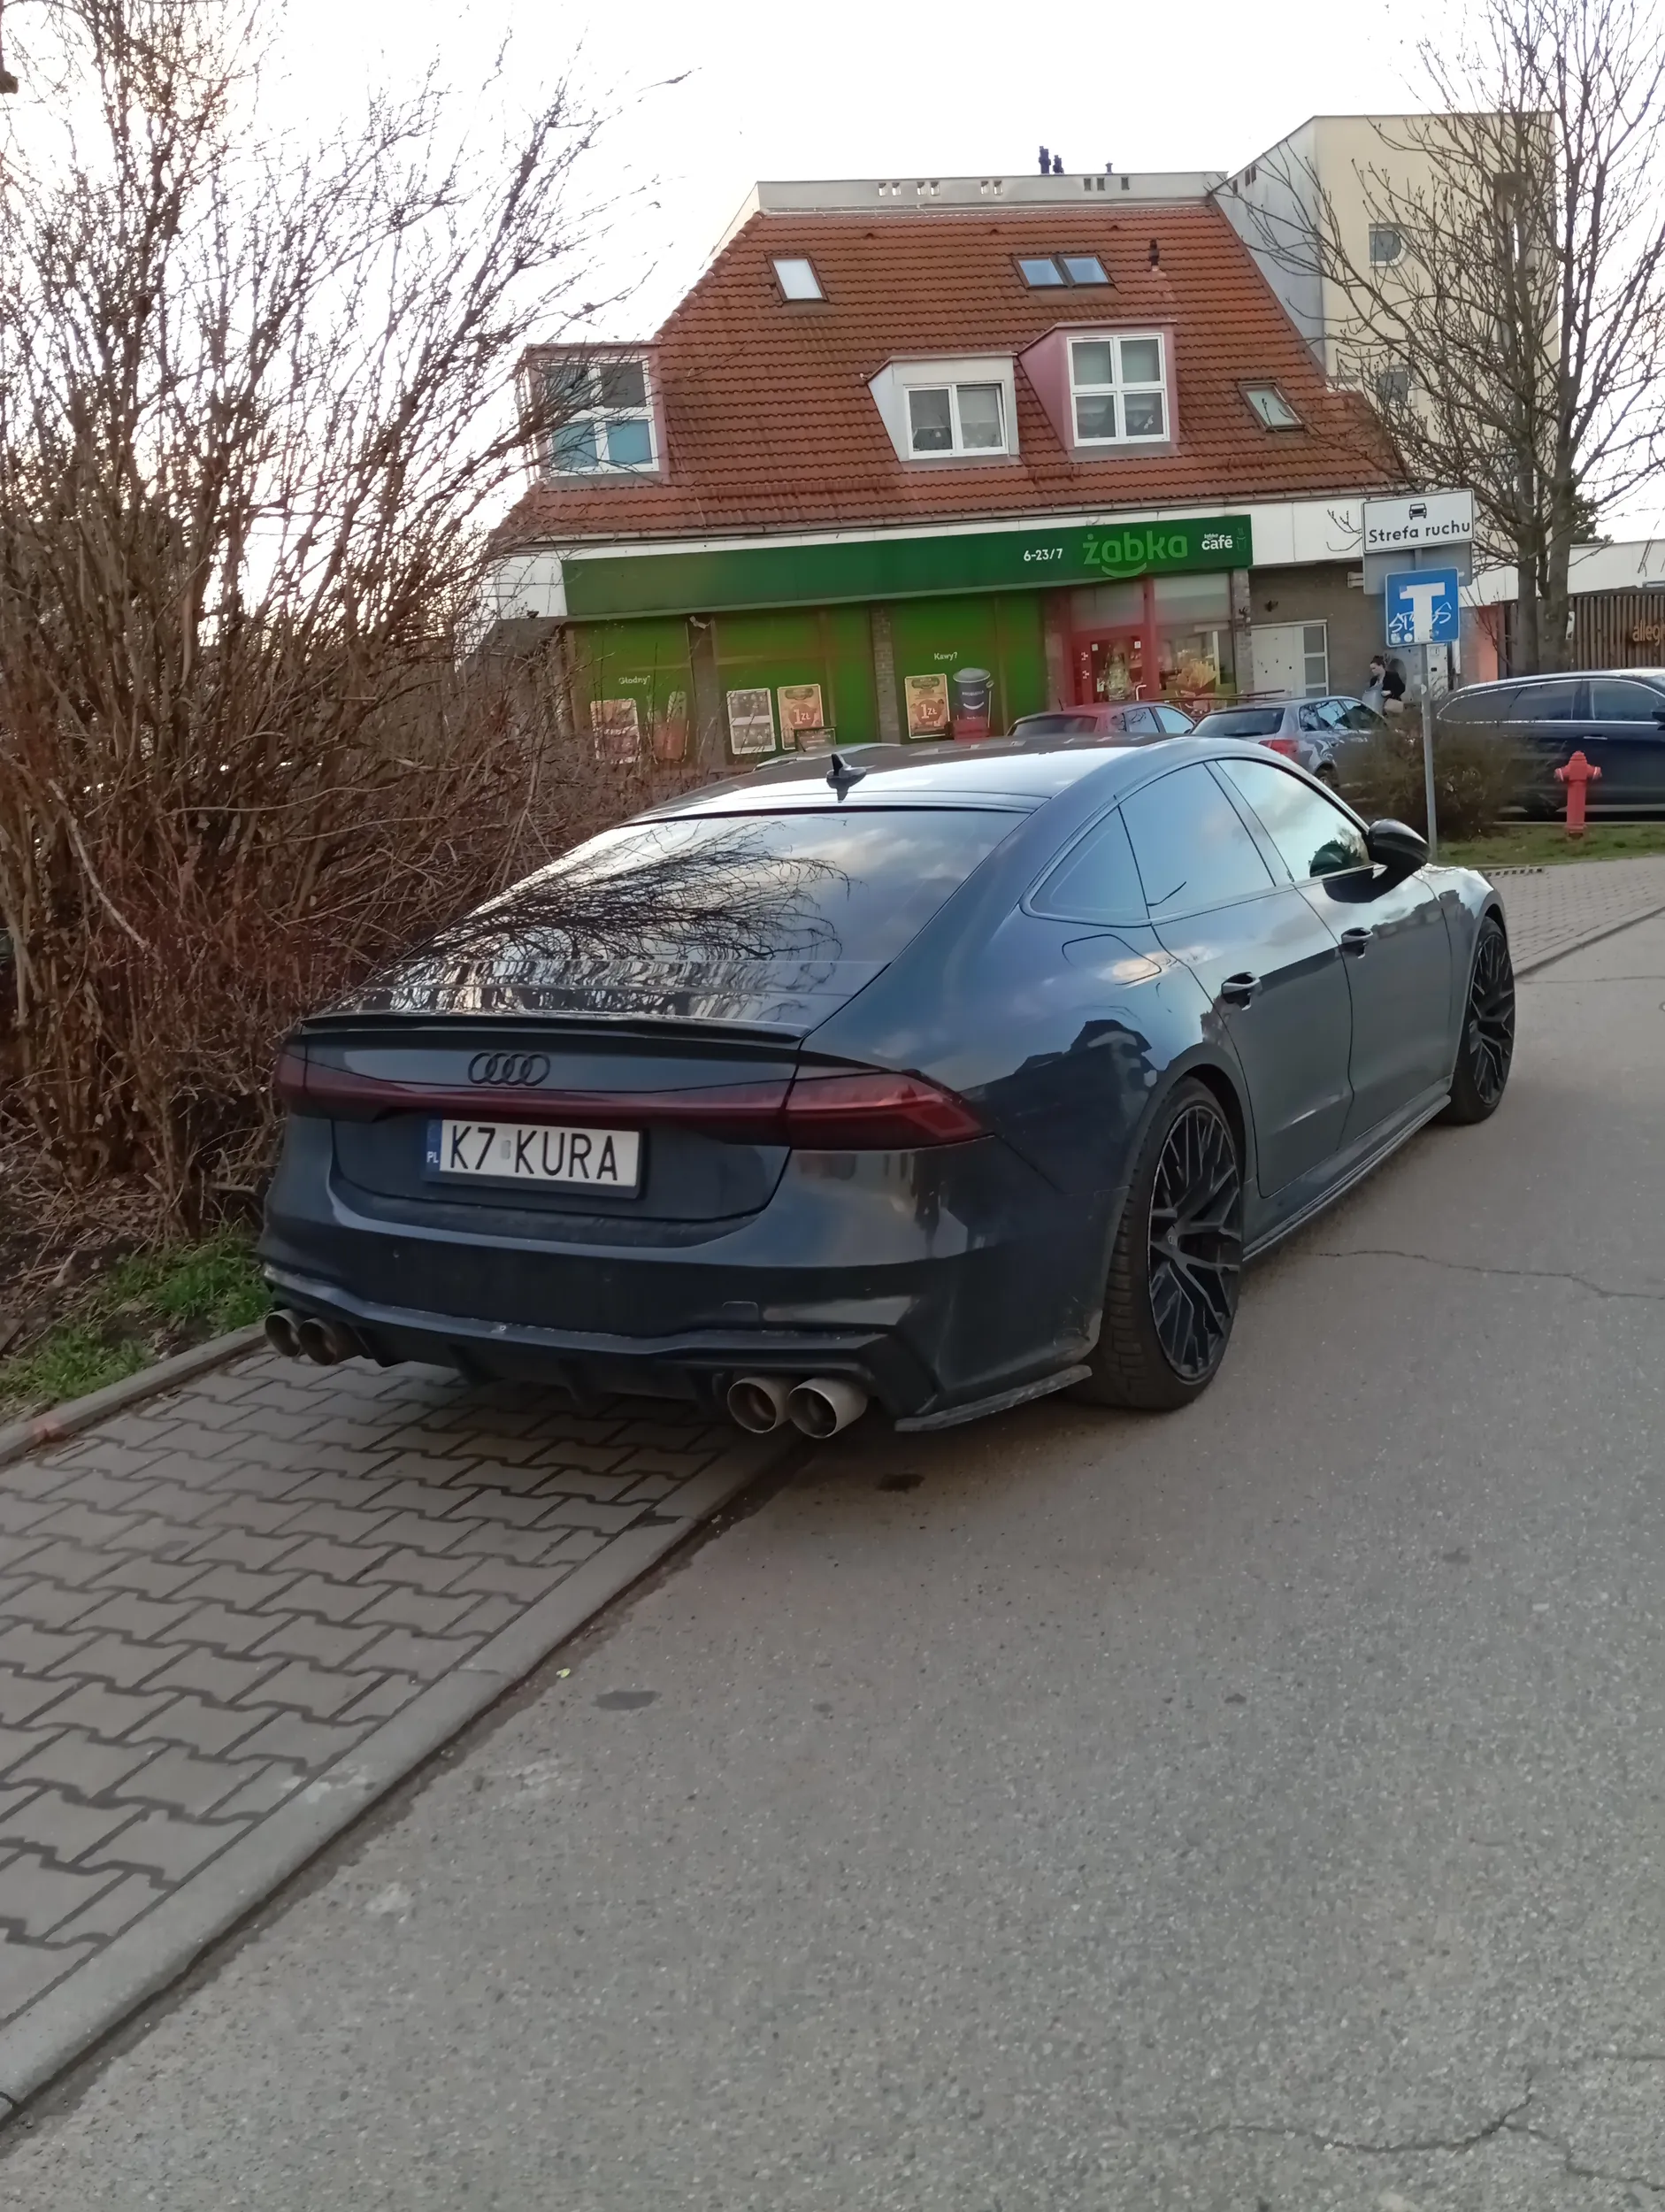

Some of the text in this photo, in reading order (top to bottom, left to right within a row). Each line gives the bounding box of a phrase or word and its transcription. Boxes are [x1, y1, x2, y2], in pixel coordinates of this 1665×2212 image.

[1369, 522, 1470, 543] Strefa ruchu
[1082, 530, 1188, 565] żabka
[1201, 534, 1233, 550] café
[1023, 548, 1063, 562] 6-23/7
[933, 651, 958, 662] Kawy?
[426, 1150, 440, 1164] PL
[449, 1125, 618, 1181] K7 KURA
